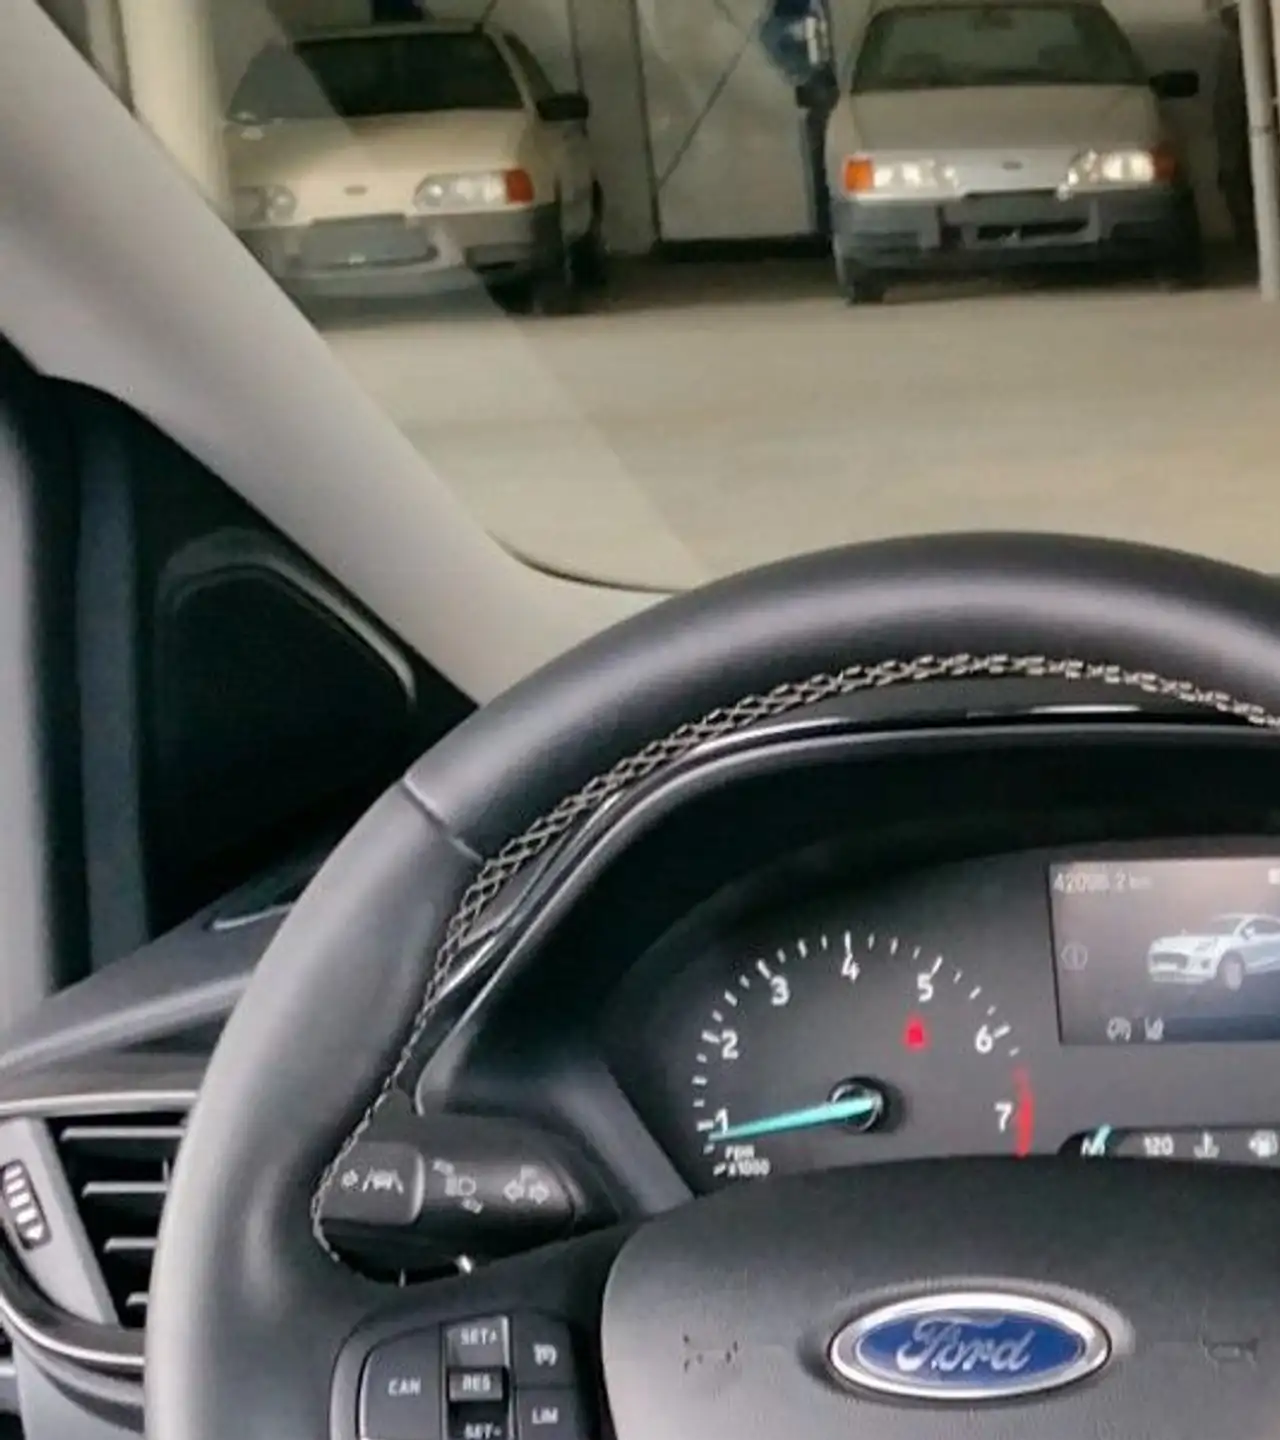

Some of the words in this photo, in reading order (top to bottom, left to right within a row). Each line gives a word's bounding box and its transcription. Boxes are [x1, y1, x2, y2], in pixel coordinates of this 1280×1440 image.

[841, 954, 859, 981] 4
[770, 977, 789, 1006] 3
[917, 973, 934, 1001] 5
[720, 1030, 739, 1060] 2
[975, 1026, 993, 1053] 6
[715, 1106, 728, 1136] 1
[994, 1103, 1013, 1131] 7
[897, 1317, 1036, 1372] Ford
[388, 1378, 422, 1397] CAN
[532, 1407, 559, 1424] LIM
